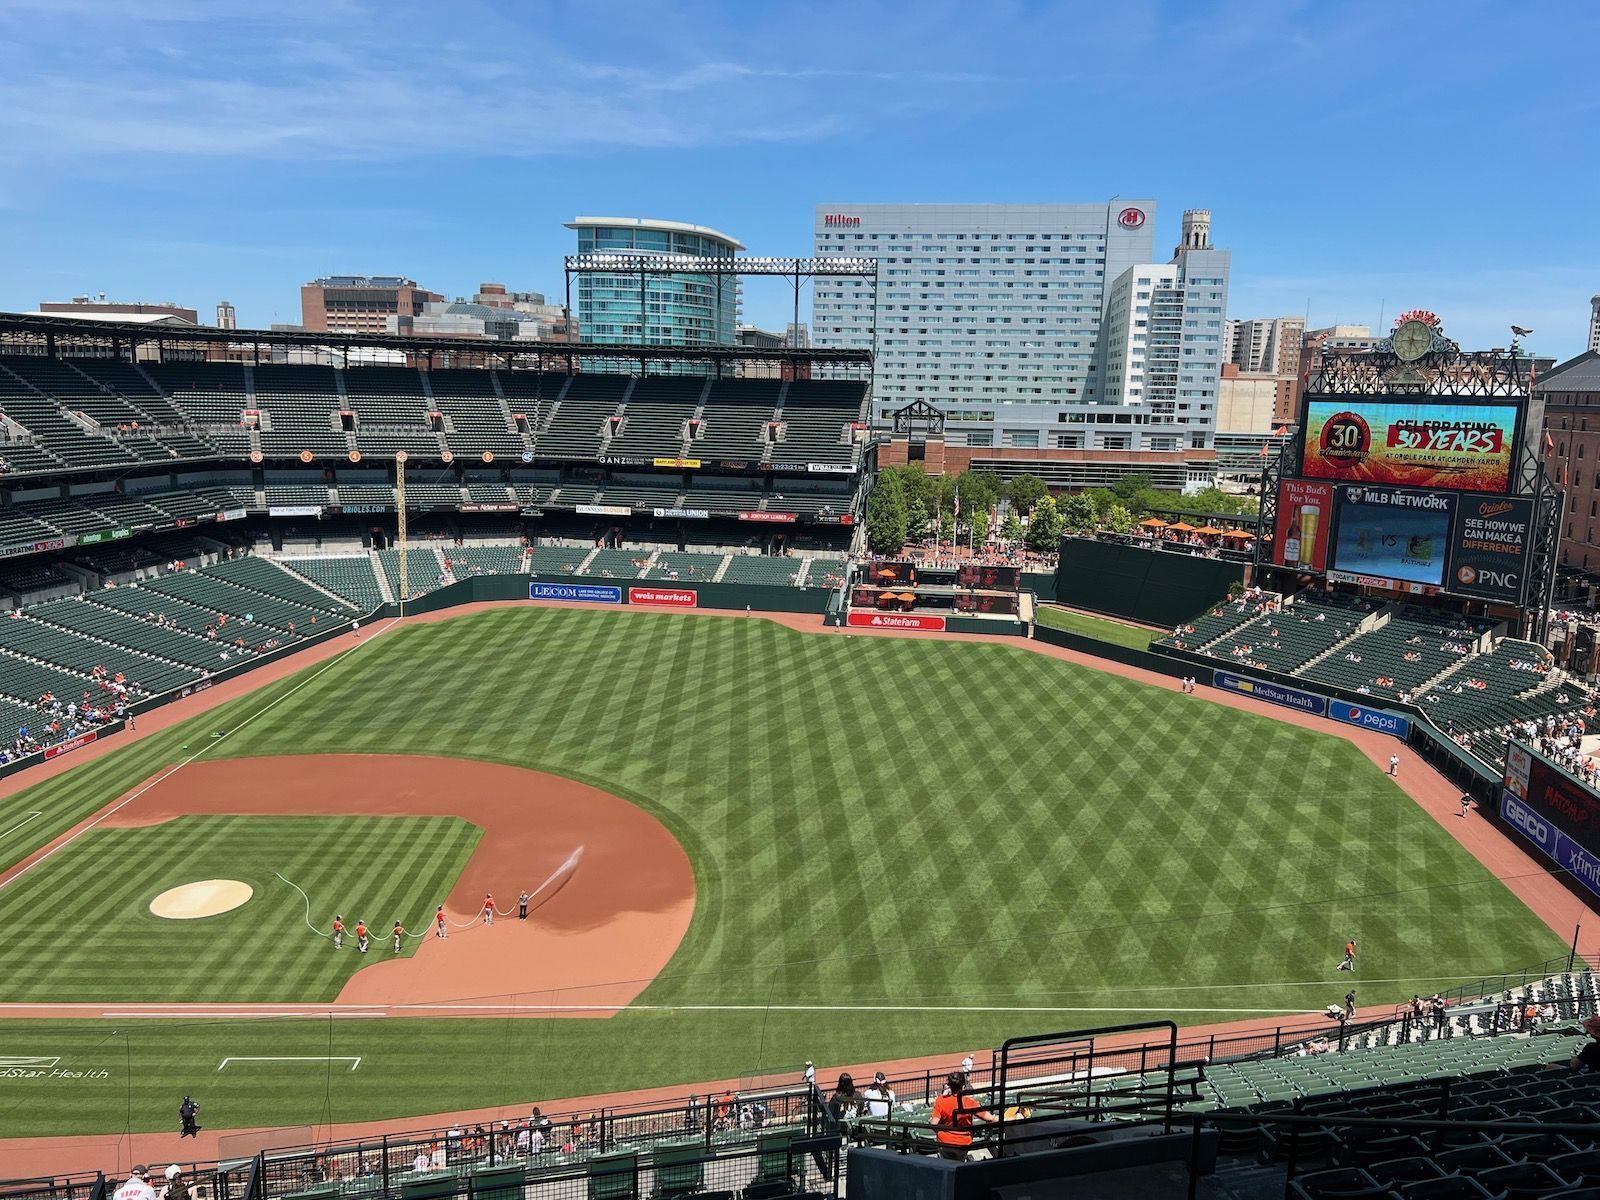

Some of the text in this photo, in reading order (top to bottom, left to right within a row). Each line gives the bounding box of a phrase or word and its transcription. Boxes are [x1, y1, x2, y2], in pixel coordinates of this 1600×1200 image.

[825, 214, 861, 225] Hilton
[1396, 420, 1498, 435] CELEBRATING
[1331, 425, 1359, 447] 30
[1395, 430, 1496, 453] 30 YEARS
[1318, 447, 1370, 464] Anniversary
[1285, 483, 1327, 496] This Bud's
[1289, 493, 1305, 503] For
[1364, 492, 1449, 511] MLB NETWORK
[342, 505, 386, 513] ORIOLES.COM
[576, 505, 603, 513] GUINNESS
[687, 509, 709, 518] UNION
[1479, 501, 1514, 516] Orioles
[1465, 518, 1526, 533] SEE HOW WE
[1381, 535, 1398, 547] VS
[1464, 529, 1523, 544] CAN MAKE A
[1462, 540, 1522, 554] DIFFERENCE
[1332, 573, 1355, 582] TODAY'S
[1478, 570, 1518, 589] PNC
[535, 587, 577, 597] LECOM
[634, 592, 692, 602] weis markets
[1254, 686, 1313, 709] MedStar Health
[1363, 713, 1397, 730] pepsi
[1506, 799, 1548, 845] GEICO
[48, 1068, 109, 1080] Health
